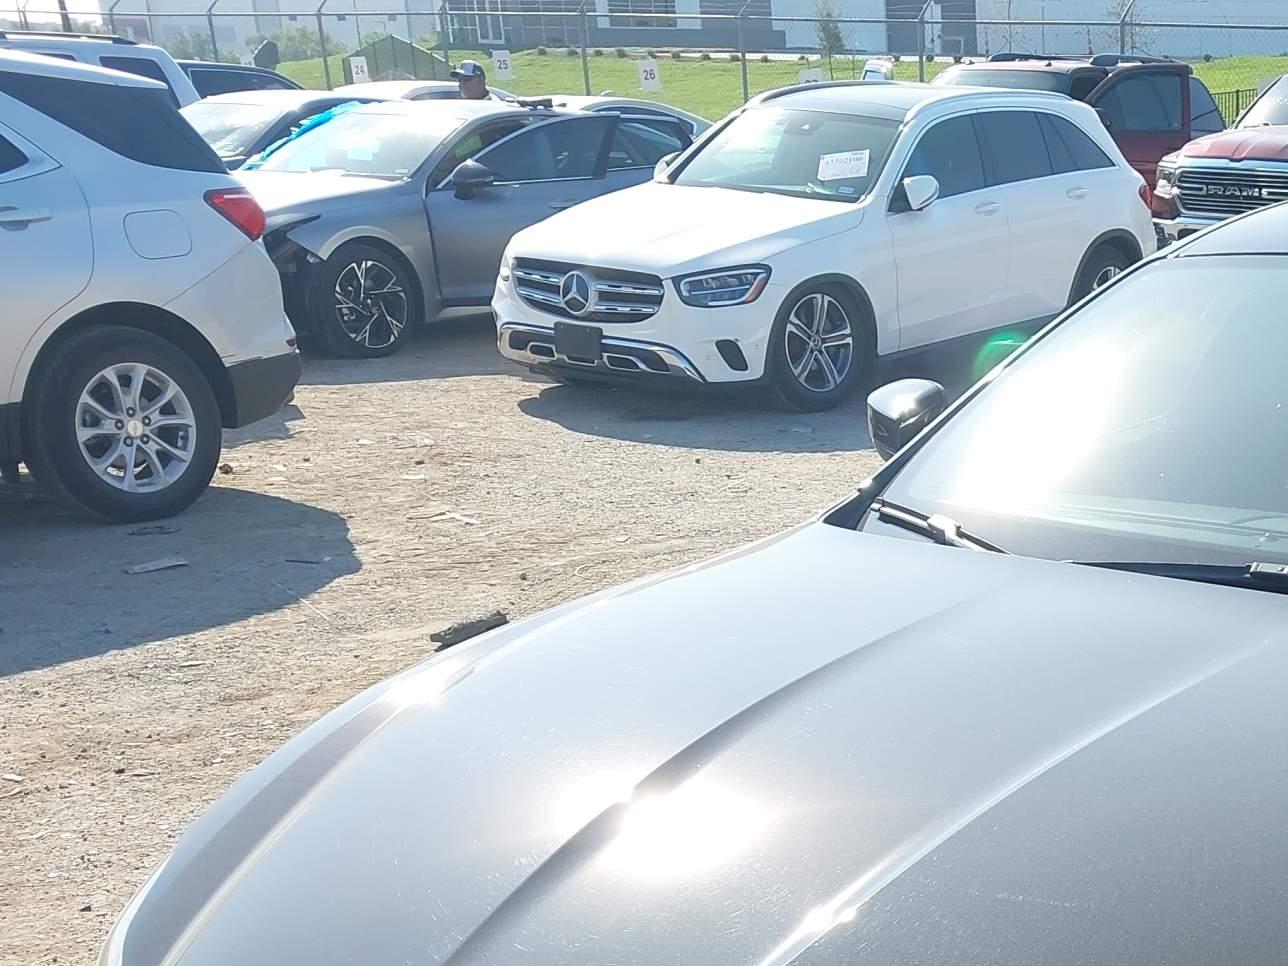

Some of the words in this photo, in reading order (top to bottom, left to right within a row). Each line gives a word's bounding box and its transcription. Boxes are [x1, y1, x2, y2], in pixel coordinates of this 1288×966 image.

[354, 65, 365, 75] 24
[496, 59, 508, 70] 25
[642, 69, 656, 80] 26
[1207, 185, 1260, 196] RAM
